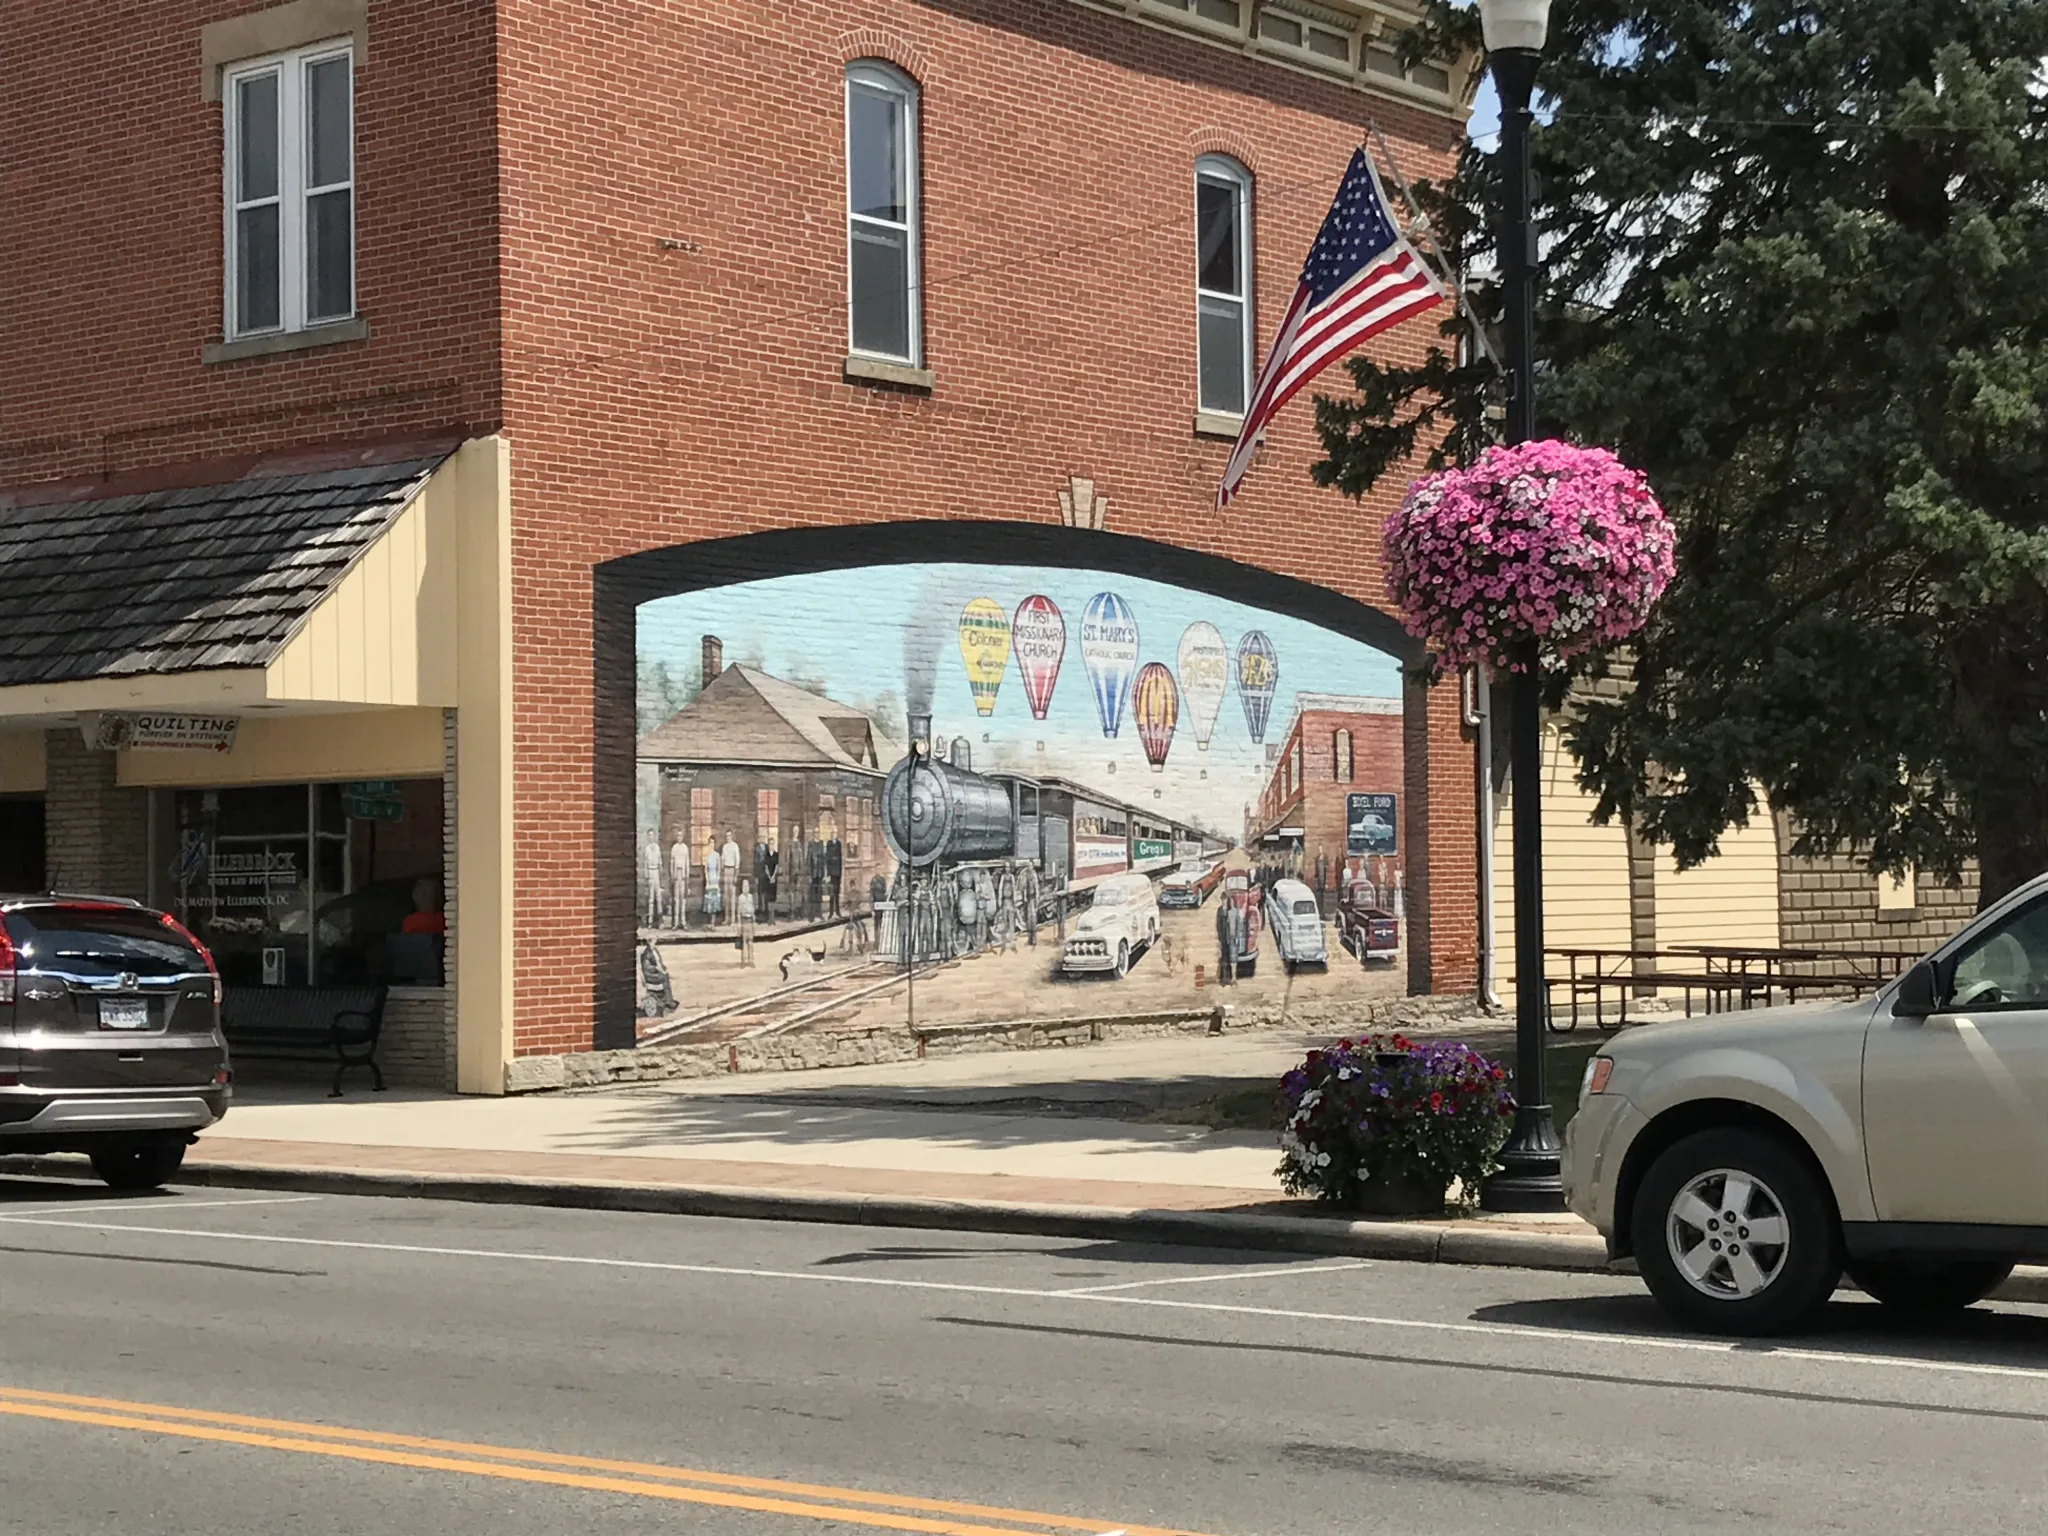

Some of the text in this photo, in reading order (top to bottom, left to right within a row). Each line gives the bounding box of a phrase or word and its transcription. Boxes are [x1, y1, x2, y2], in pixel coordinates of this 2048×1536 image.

[1028, 610, 1049, 623] FIRST
[1015, 625, 1064, 640] MISSIONARY
[1100, 626, 1135, 644] MARY'S
[1023, 643, 1058, 658] CHURCH
[1085, 649, 1135, 660] CATHOLIC CHURCH
[138, 717, 236, 731] QUILTING
[208, 852, 296, 871] ELLERBROCK
